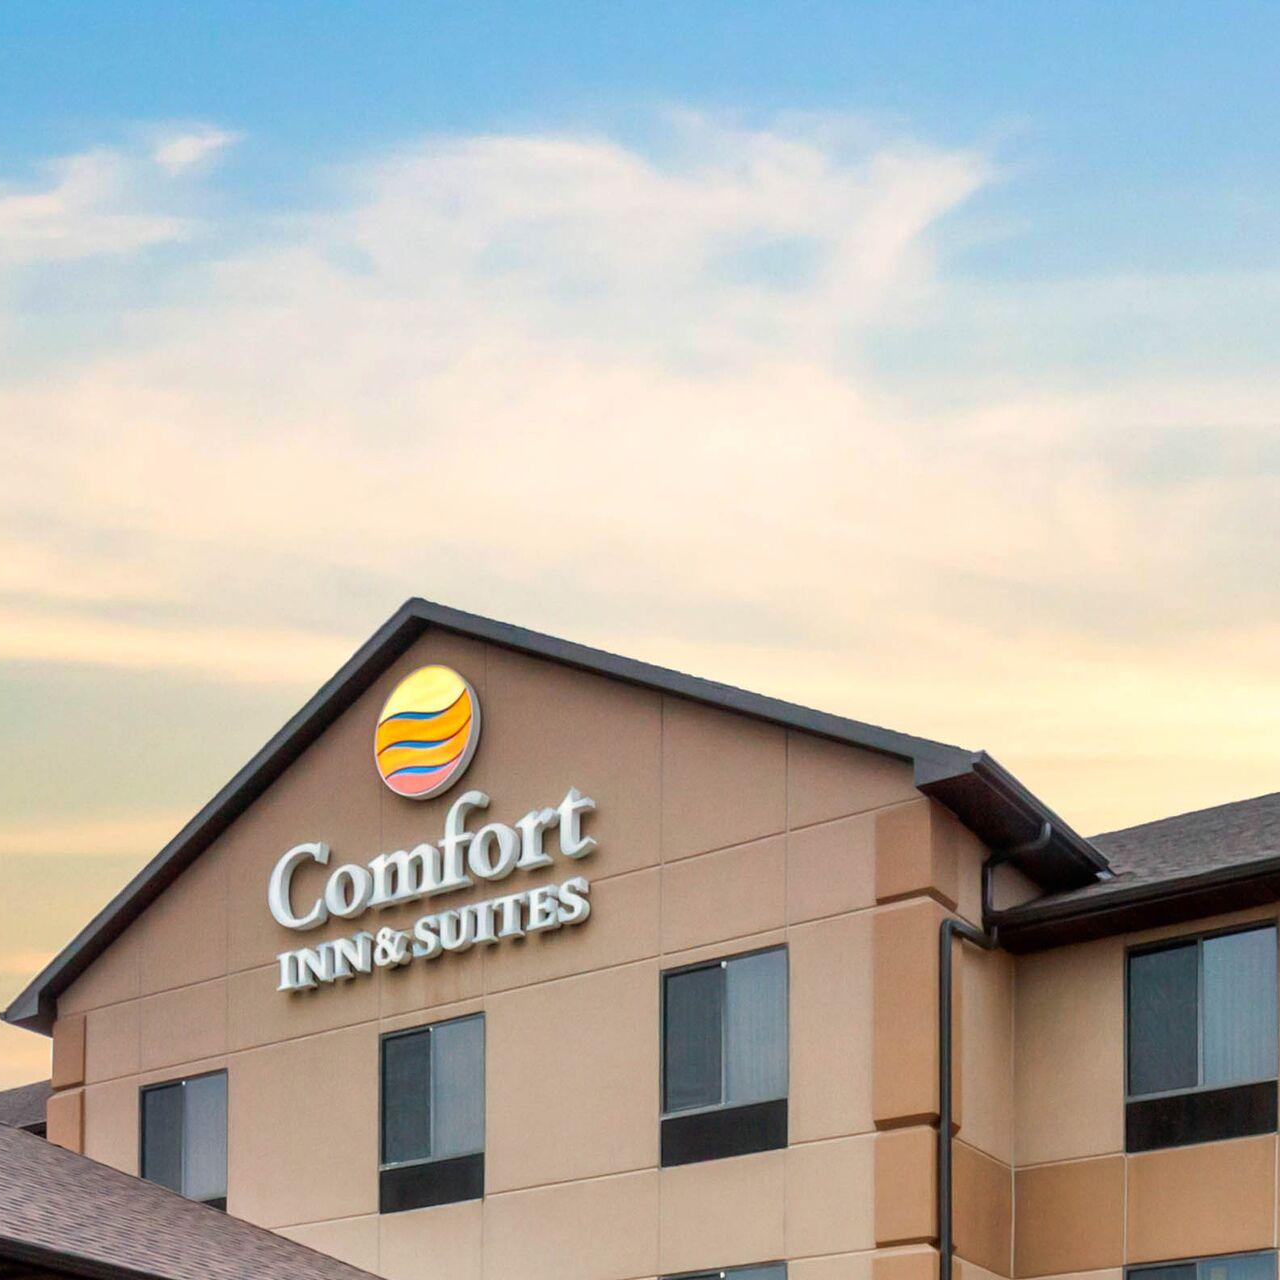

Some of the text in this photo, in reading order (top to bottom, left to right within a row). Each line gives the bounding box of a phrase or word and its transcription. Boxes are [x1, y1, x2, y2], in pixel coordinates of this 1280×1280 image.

[267, 786, 597, 931] Comfort
[276, 929, 373, 991] INN
[411, 876, 590, 960] SUITES
